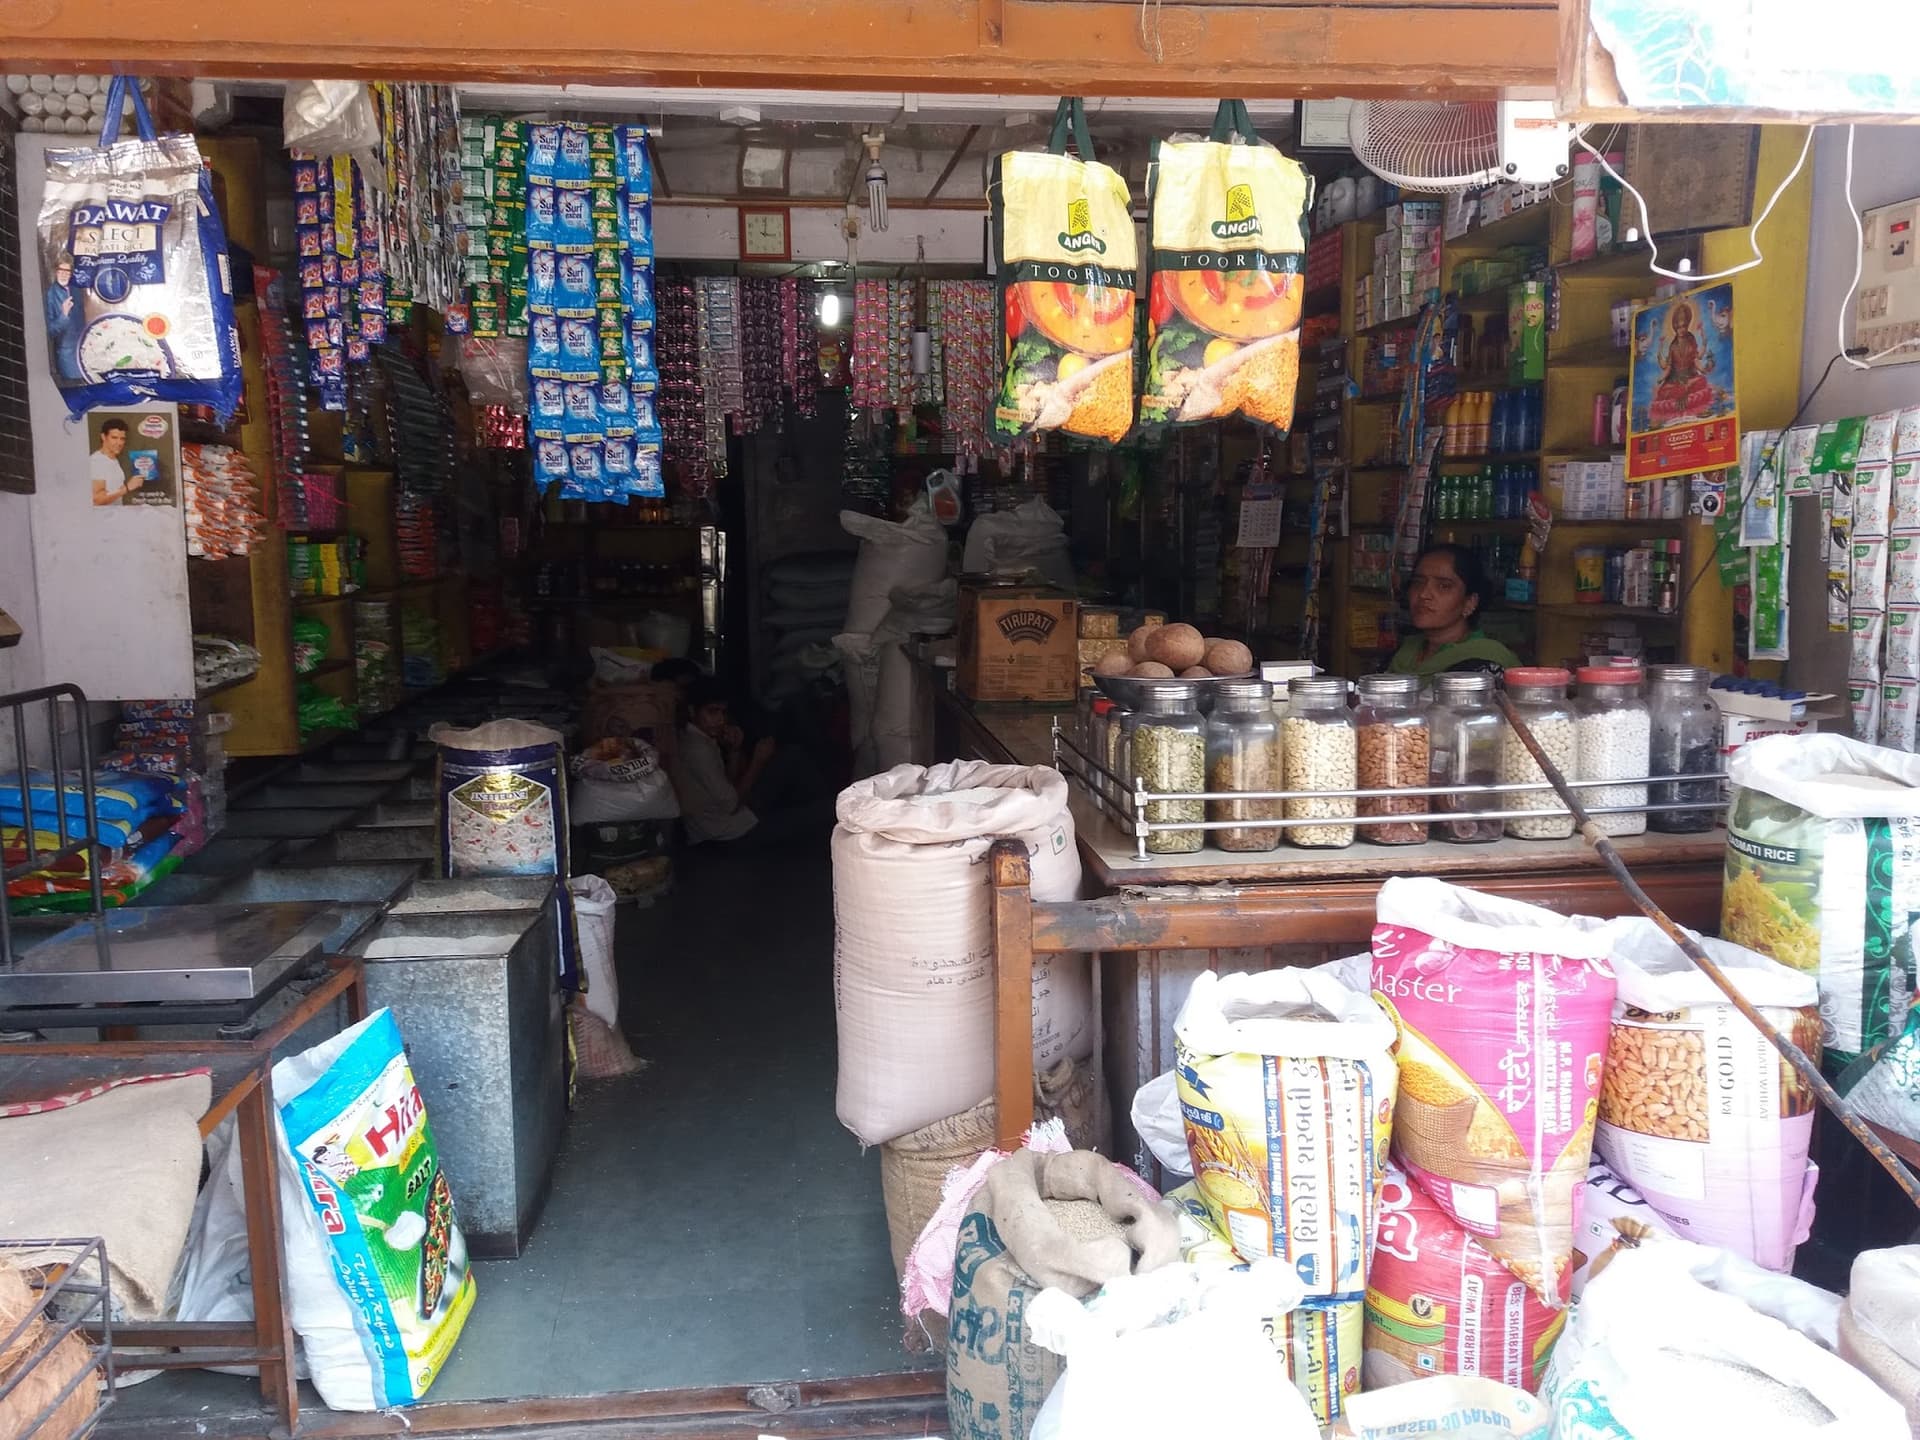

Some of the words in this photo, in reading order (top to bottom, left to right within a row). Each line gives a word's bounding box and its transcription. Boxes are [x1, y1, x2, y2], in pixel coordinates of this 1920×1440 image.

[566, 202, 585, 213] Surf
[1032, 264, 1094, 281] TOOR
[1181, 254, 1246, 269] TOOR
[568, 331, 587, 343] Surf
[999, 612, 1053, 632] TIRUPATI
[1763, 847, 1797, 863] RICE
[1370, 965, 1464, 1003] Master
[1716, 1035, 1736, 1091] GOLD
[1286, 1086, 1316, 1164] શરબતી
[407, 1156, 431, 1200] SALT
[1464, 1318, 1477, 1371] SHARBATI
[1508, 1311, 1520, 1364] SHARBATI
